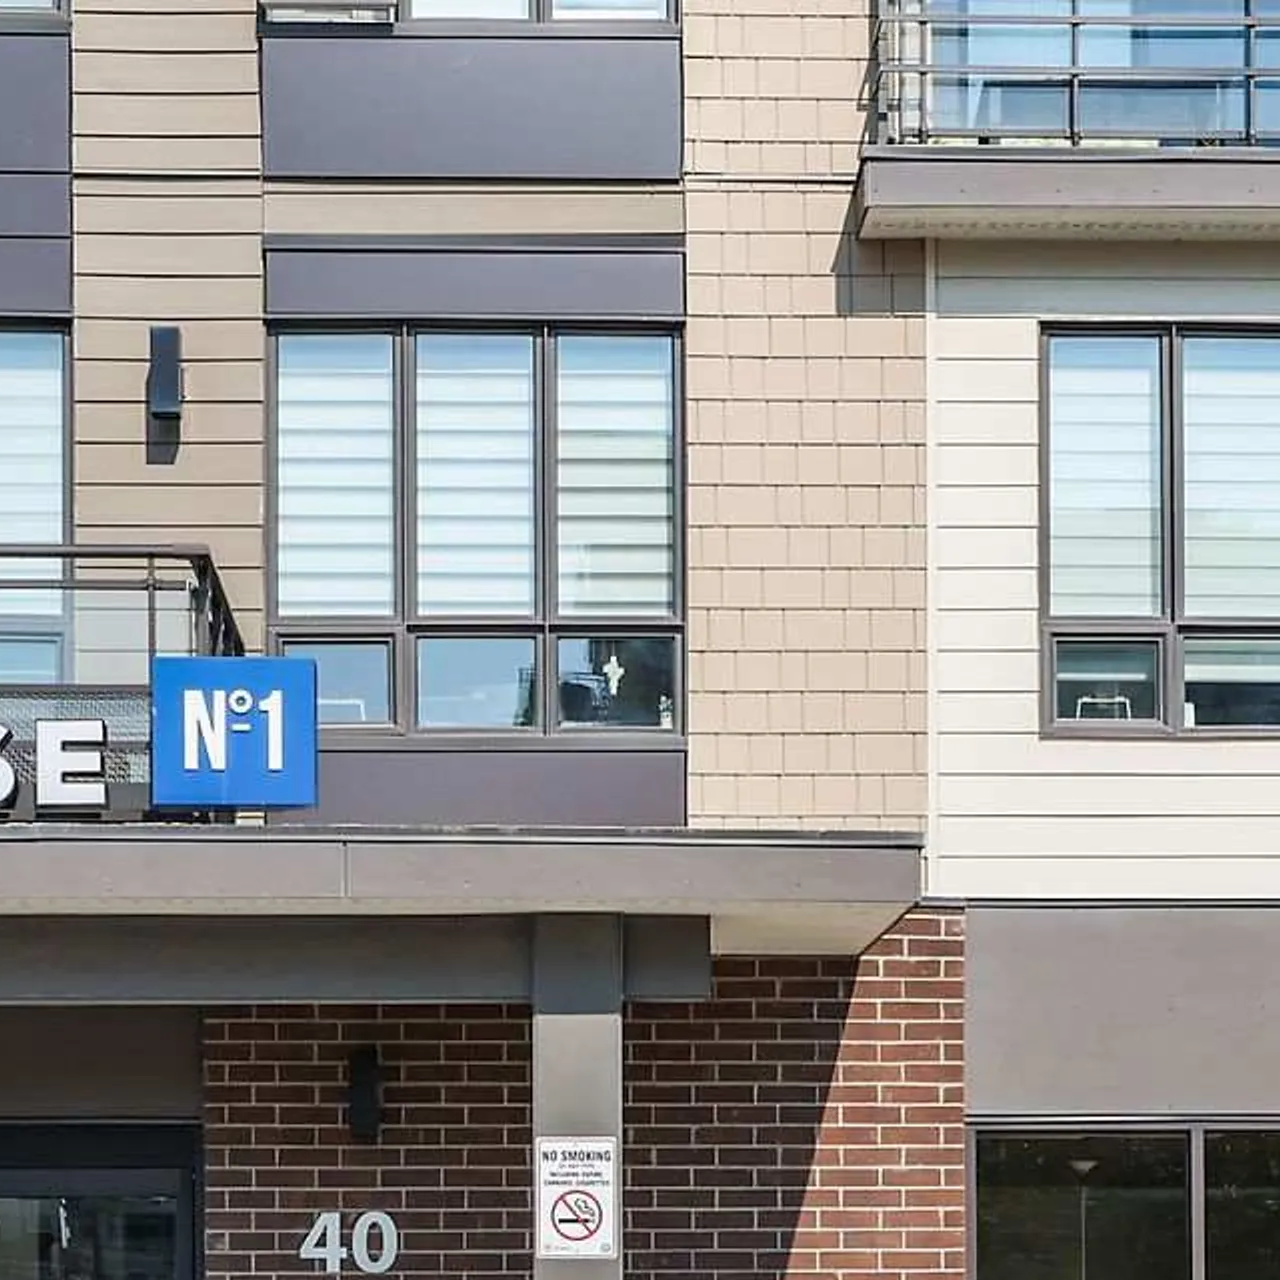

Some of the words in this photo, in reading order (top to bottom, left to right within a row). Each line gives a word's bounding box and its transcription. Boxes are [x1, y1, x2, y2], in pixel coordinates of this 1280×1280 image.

[542, 1150, 558, 1162] NO
[561, 1150, 611, 1162] SMOKING
[299, 1211, 398, 1274] 40
